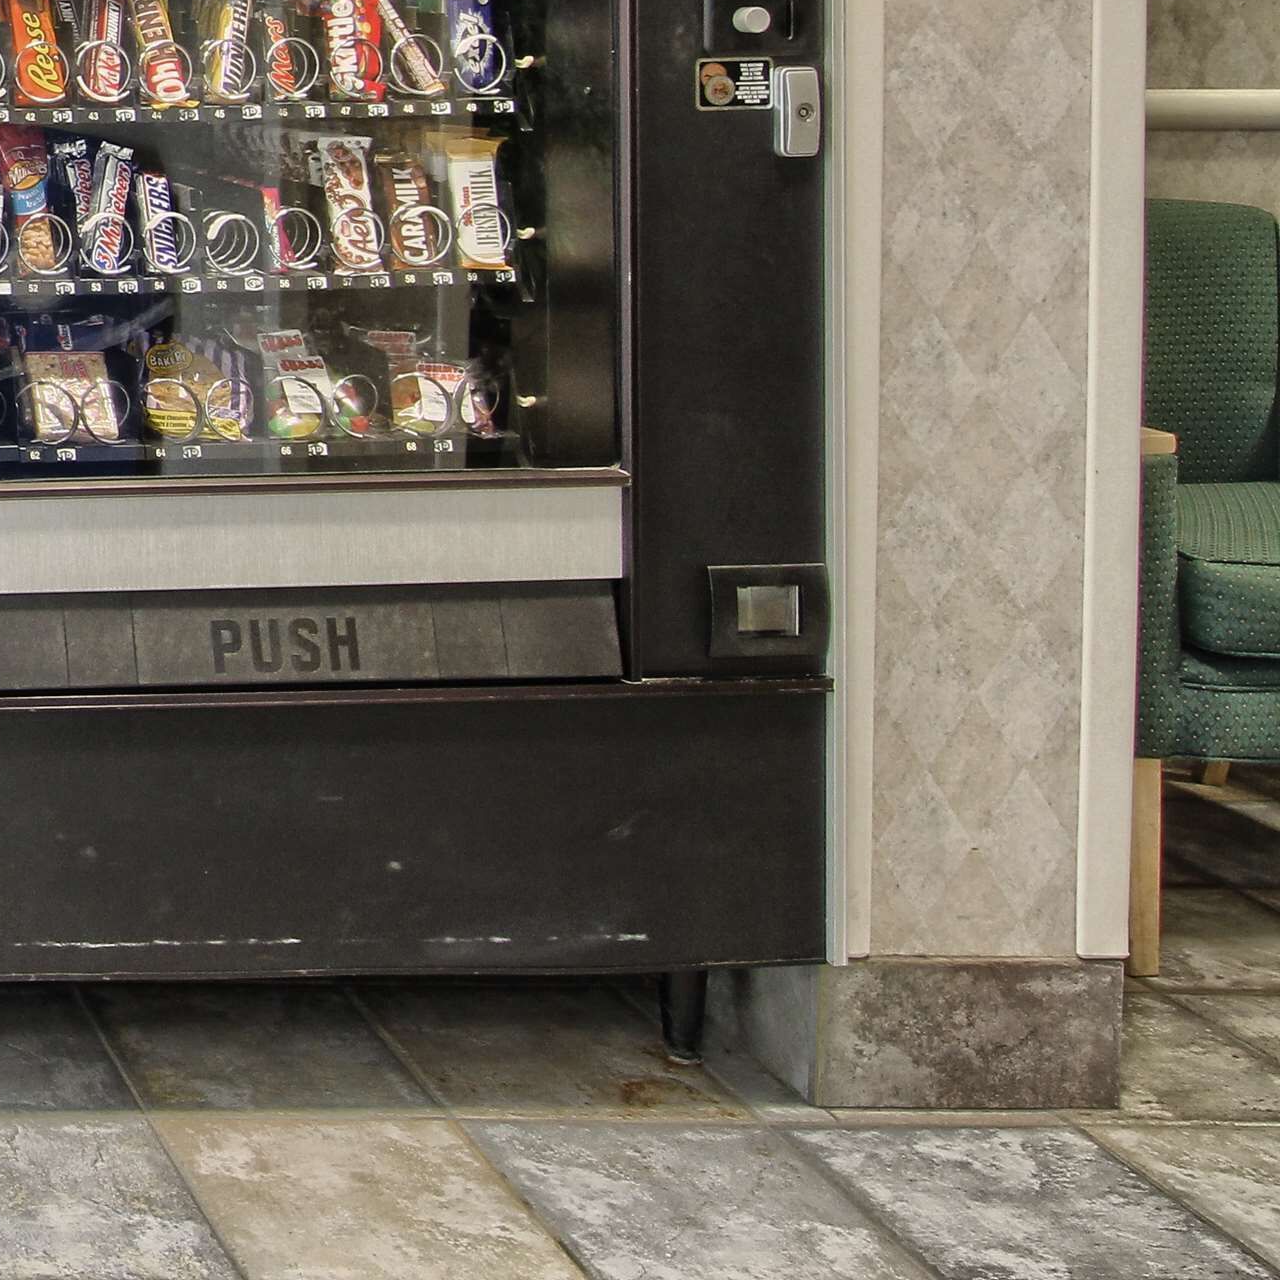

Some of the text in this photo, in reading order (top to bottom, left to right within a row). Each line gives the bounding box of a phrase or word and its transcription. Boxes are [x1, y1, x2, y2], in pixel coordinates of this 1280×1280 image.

[265, 14, 296, 94] Mars
[340, 106, 351, 115] 47
[466, 103, 477, 112] 49
[25, 112, 36, 122] 42
[88, 111, 99, 121] 43
[151, 111, 162, 120] 44
[214, 109, 225, 119] 45
[404, 274, 416, 284] 58
[467, 272, 478, 282] 59
[28, 283, 39, 293] 52
[91, 282, 102, 292] 53
[154, 281, 165, 290] 54
[216, 280, 228, 290] 55
[279, 279, 290, 288] 56
[150, 351, 186, 367] BAKERY
[406, 441, 417, 451] 68
[30, 450, 40, 460] 62
[155, 448, 166, 457] 64
[212, 615, 362, 675] PUSH
